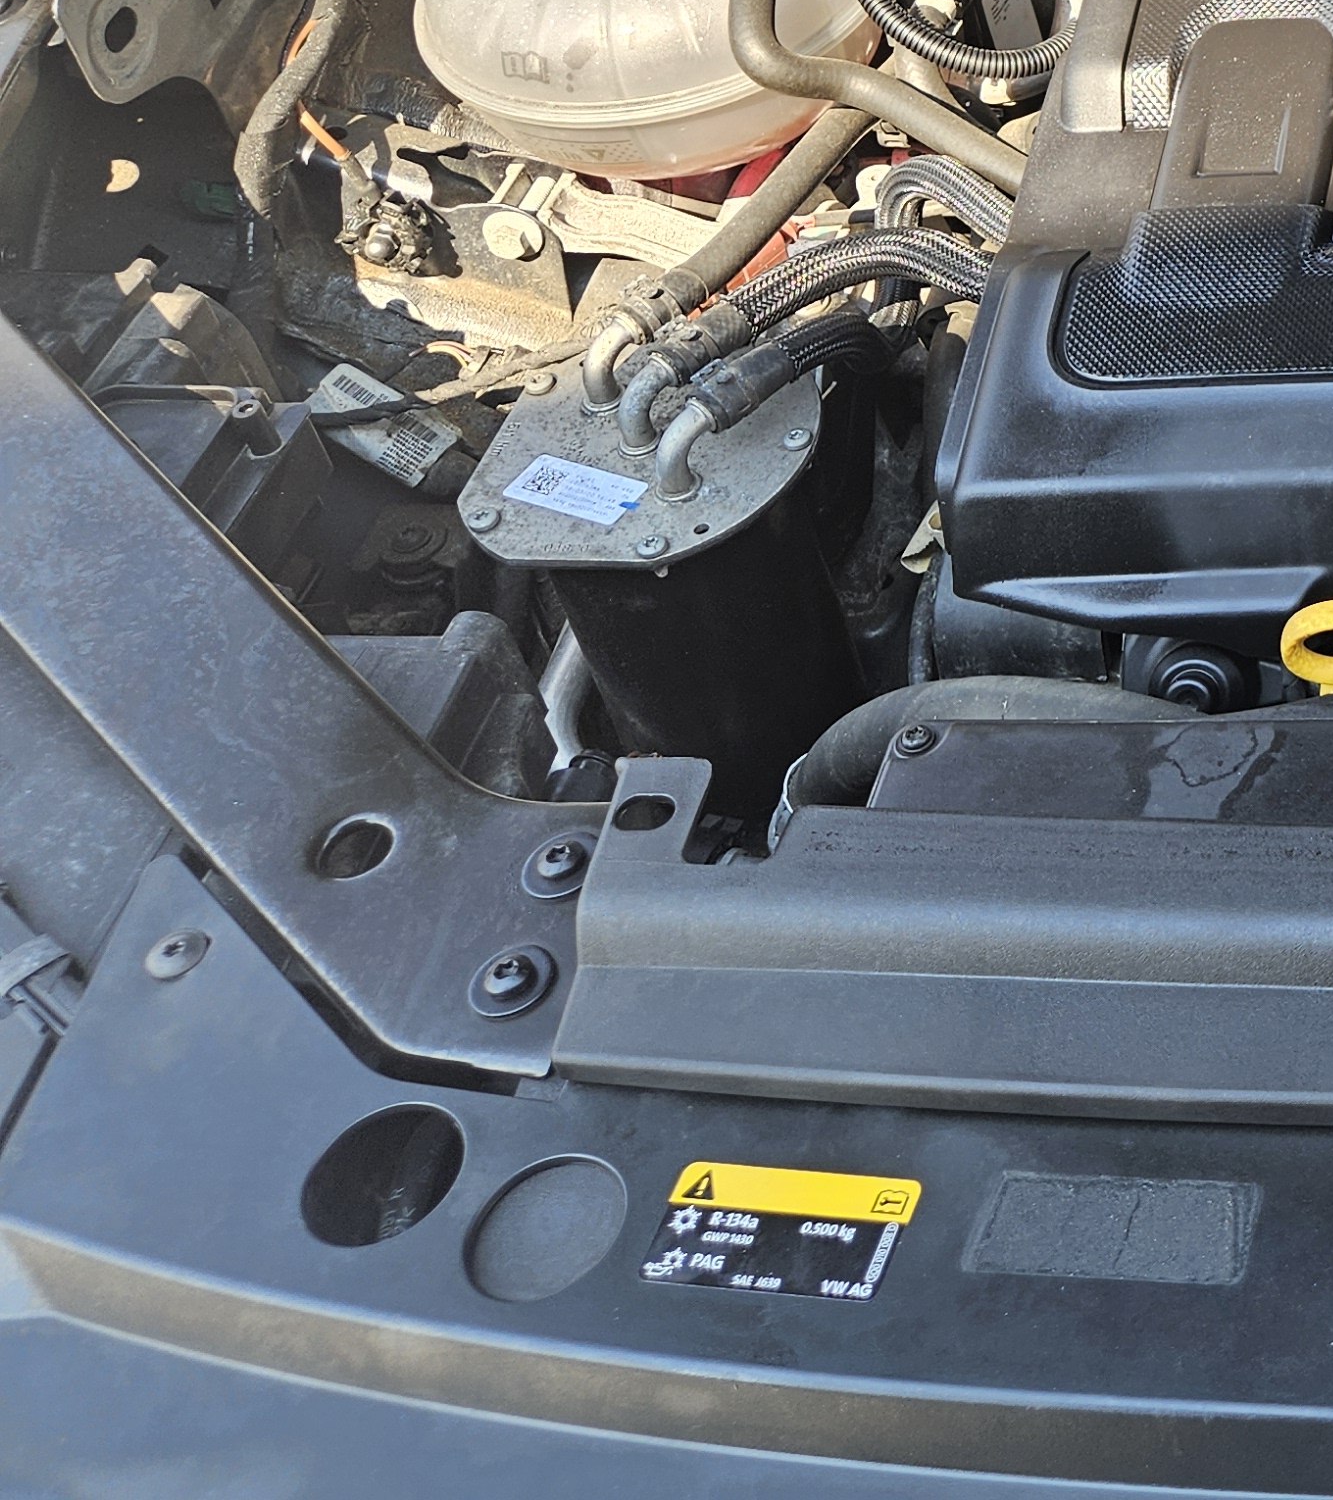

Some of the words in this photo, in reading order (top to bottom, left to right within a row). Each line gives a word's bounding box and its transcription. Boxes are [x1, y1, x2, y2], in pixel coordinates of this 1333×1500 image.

[708, 1211, 760, 1230] R-134a
[799, 1220, 838, 1236] 0.500
[838, 1224, 857, 1242] kg
[701, 1231, 729, 1243] GWP
[729, 1232, 754, 1245] 1430
[689, 1253, 726, 1270] PAG
[731, 1274, 754, 1287] SAE
[755, 1276, 782, 1290] J639
[821, 1280, 850, 1295] VW
[849, 1281, 873, 1298] AG
